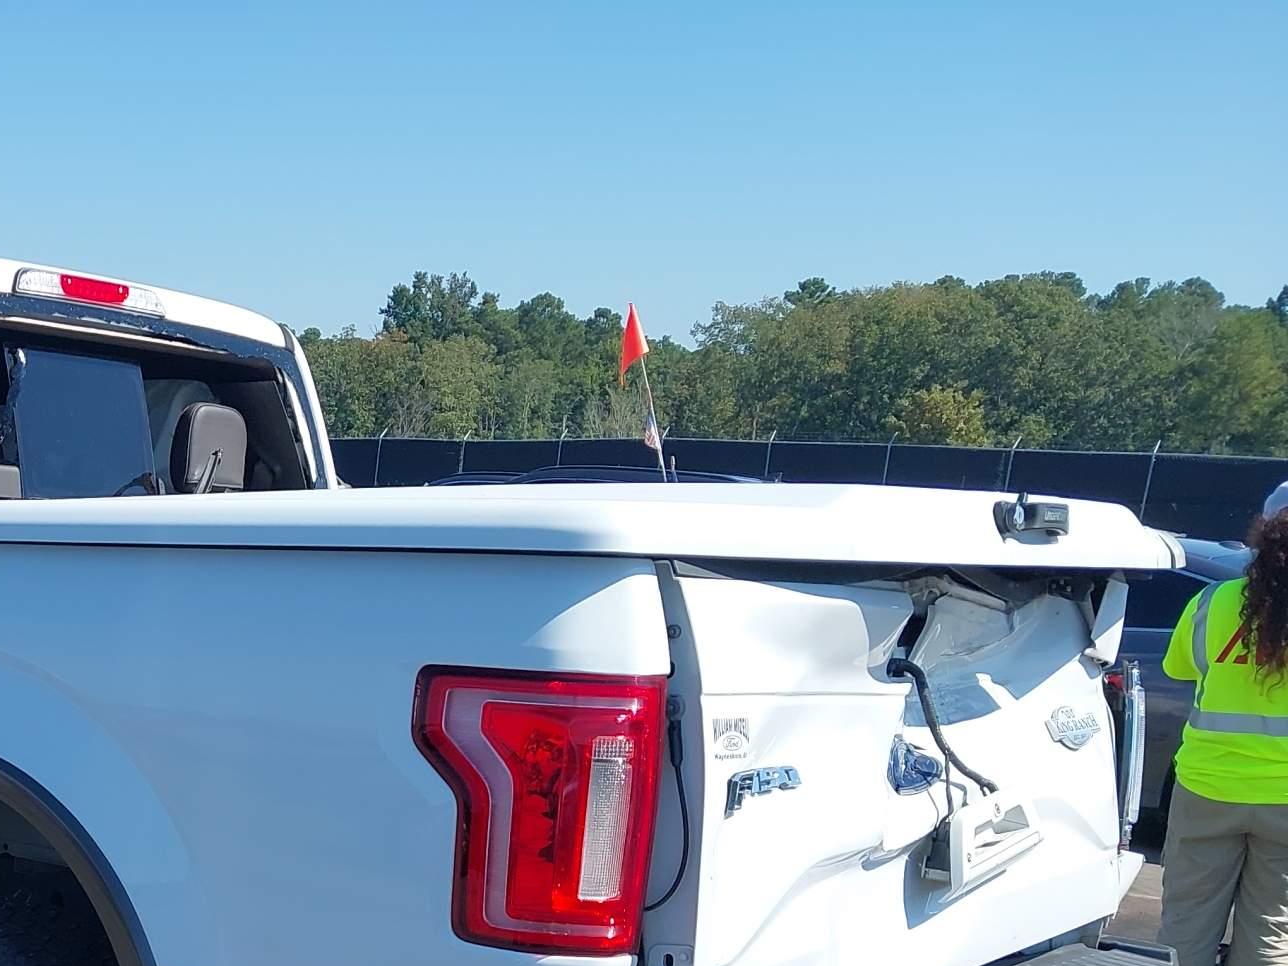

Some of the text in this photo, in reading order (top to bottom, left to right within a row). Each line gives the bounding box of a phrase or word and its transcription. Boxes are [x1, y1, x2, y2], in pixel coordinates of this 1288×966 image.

[712, 717, 733, 745] WILLIAM
[1056, 714, 1098, 734] KING RANCH
